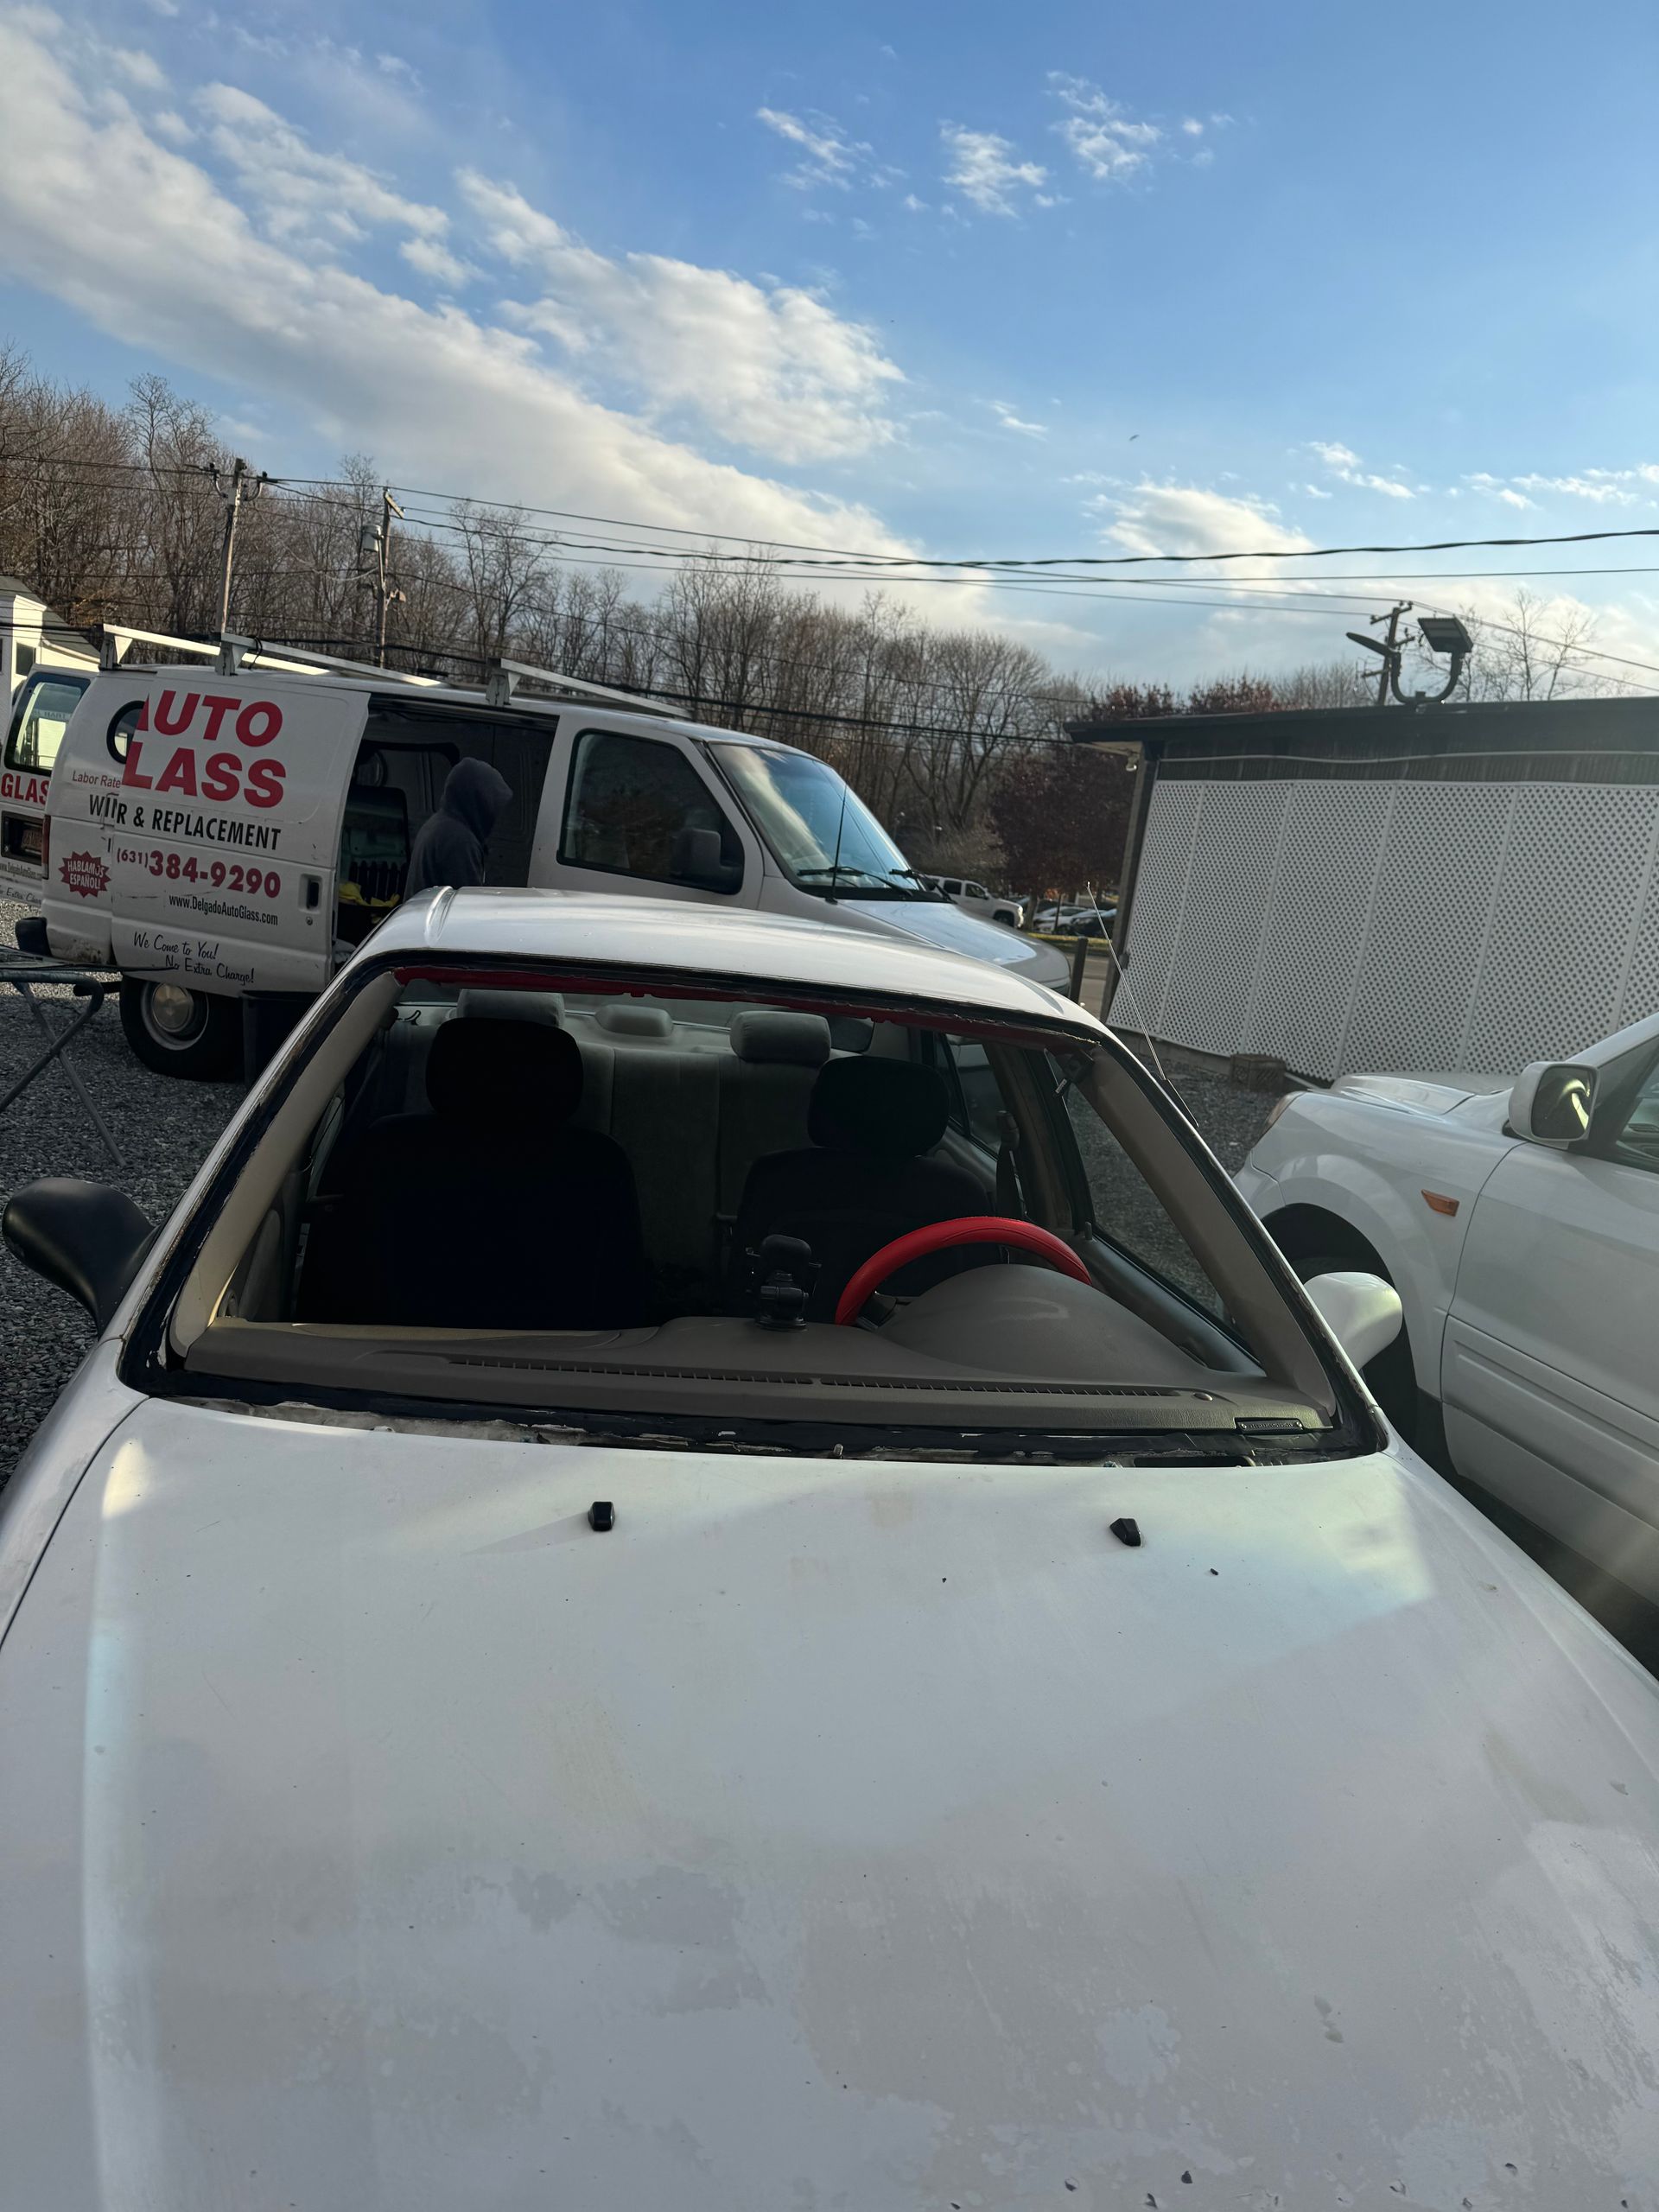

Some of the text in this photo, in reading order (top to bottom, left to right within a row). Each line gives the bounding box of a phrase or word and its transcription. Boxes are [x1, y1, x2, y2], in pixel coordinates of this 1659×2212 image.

[73, 770, 122, 789] Labor Rate
[133, 806, 145, 828] &
[152, 808, 282, 851] REPLACEMENT
[67, 860, 105, 878] HABLAMOS
[69, 873, 101, 890] ESPAÑOL!
[168, 895, 278, 926] www.DelgadoAutoGlass.com
[134, 931, 219, 960] We Come to You!
[185, 957, 212, 976] Extra
[217, 963, 255, 986] Charge!
